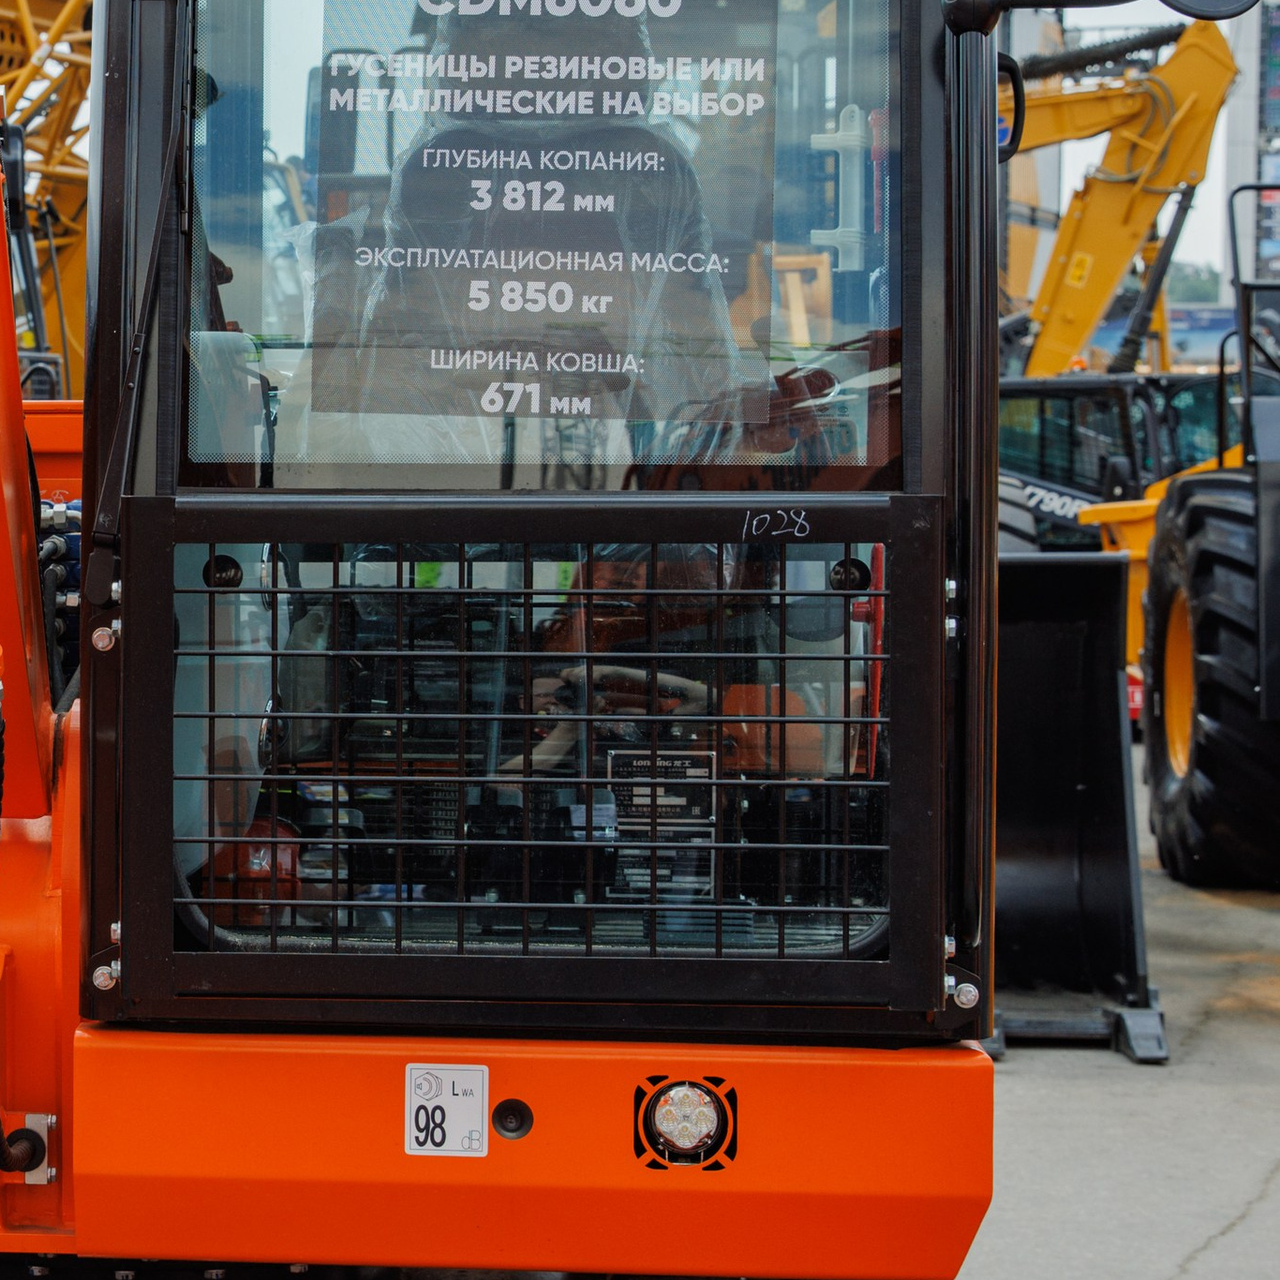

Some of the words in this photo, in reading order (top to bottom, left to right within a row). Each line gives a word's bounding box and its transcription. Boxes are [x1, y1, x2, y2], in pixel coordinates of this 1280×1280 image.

[330, 54, 497, 82] ГУСЕНИЦЫ
[505, 55, 692, 81] РЕЗИНОВЫЕ
[701, 58, 765, 81] ИЛИ
[330, 88, 594, 115] МЕТАЛЛИЧЕСКИЕ
[603, 92, 645, 115] НА
[653, 92, 765, 116] ВЫБОР
[423, 149, 534, 171] ГЛУБИНА
[540, 150, 665, 171] КОПАНИЯ:
[470, 180, 493, 211] 3
[502, 180, 566, 212] 812
[574, 193, 615, 212] мм
[355, 248, 624, 273] ЭКСПЛУАТАЦИОННАЯ
[631, 252, 730, 274] МАССА:
[468, 280, 491, 311] 5
[500, 281, 573, 313] 850
[582, 294, 613, 314] кг
[430, 349, 539, 372] ШИРИНА
[547, 351, 645, 373] КОВША:
[480, 382, 540, 414] 671
[550, 396, 592, 415] мм
[742, 509, 810, 542] 1028
[633, 758, 672, 767] LONING
[415, 1104, 446, 1148] 98
[461, 1129, 481, 1151] dB
